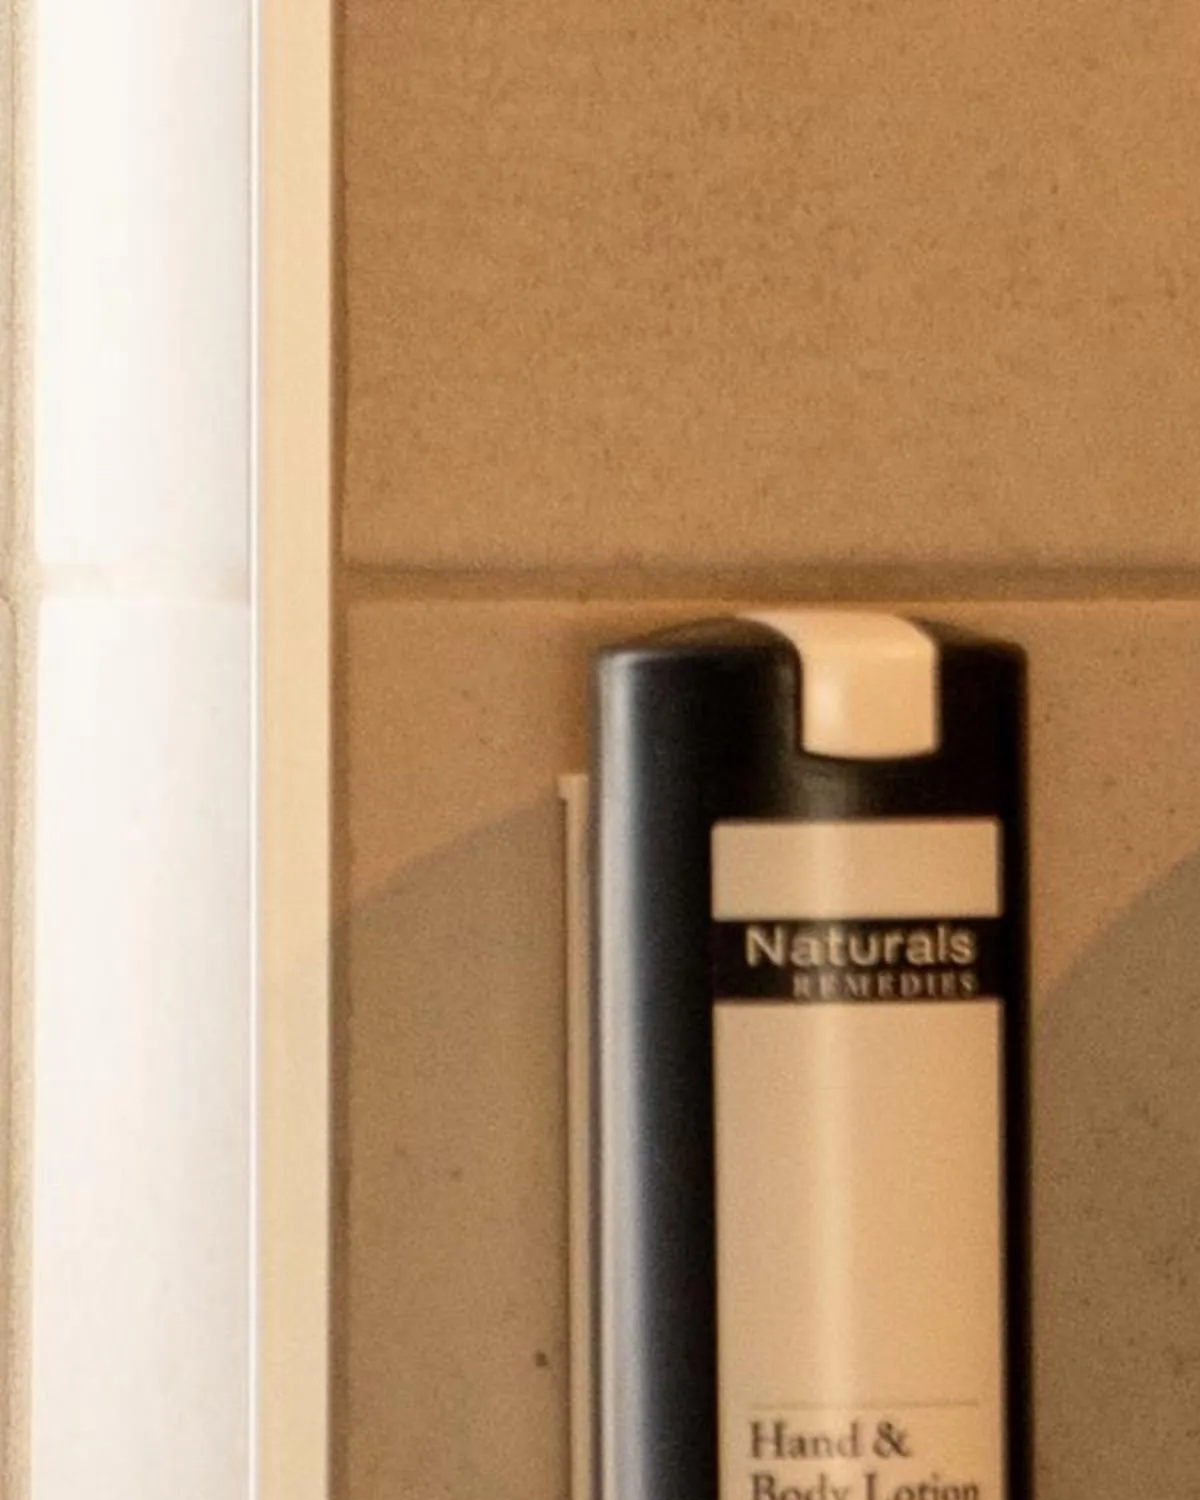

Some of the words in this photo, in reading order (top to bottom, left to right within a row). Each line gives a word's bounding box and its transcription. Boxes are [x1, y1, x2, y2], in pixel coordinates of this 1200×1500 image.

[746, 923, 977, 966] Naturals
[793, 970, 977, 998] REMEDIES
[750, 1419, 858, 1459] Hand
[872, 1420, 912, 1459] &
